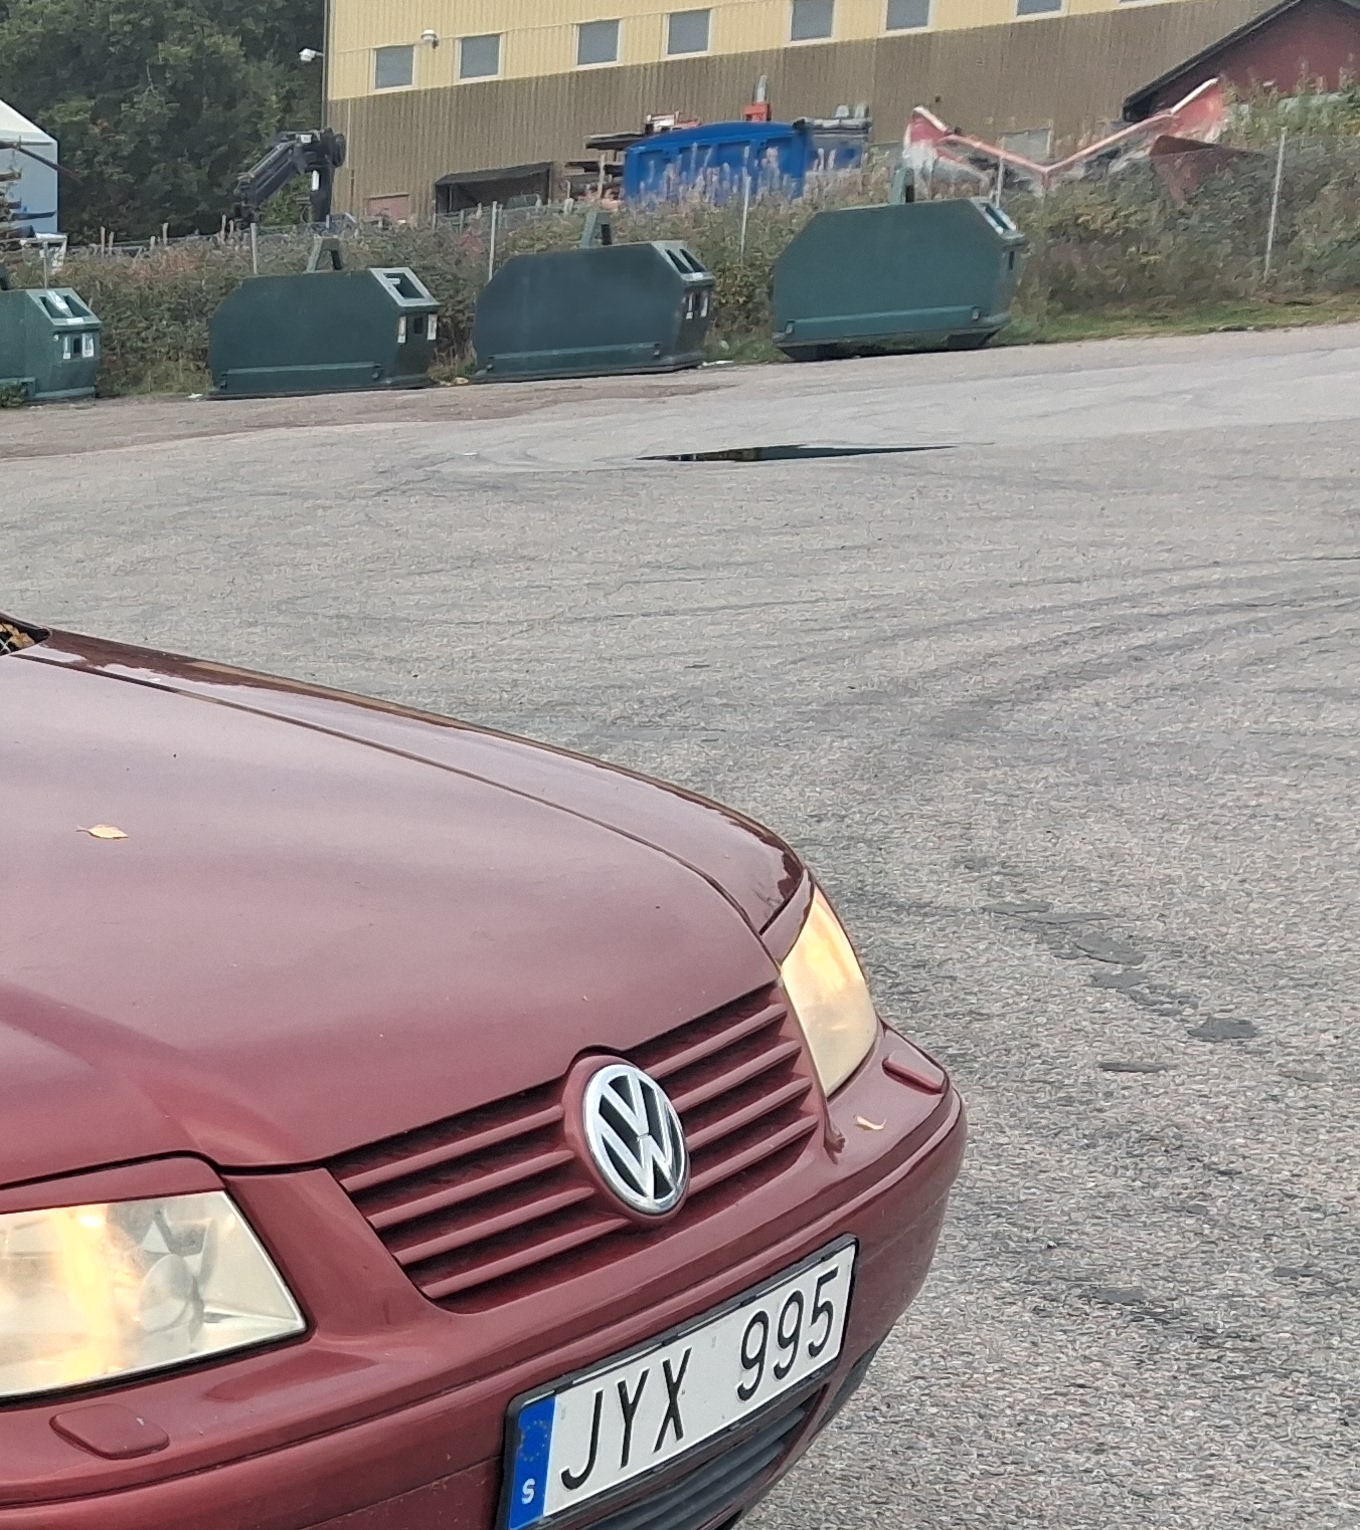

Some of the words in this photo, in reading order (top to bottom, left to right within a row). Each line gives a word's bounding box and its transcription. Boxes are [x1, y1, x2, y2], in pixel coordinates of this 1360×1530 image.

[585, 1066, 689, 1212] VW
[560, 1347, 693, 1490] JYX
[737, 1265, 839, 1402] 995
[521, 1478, 536, 1504] S
